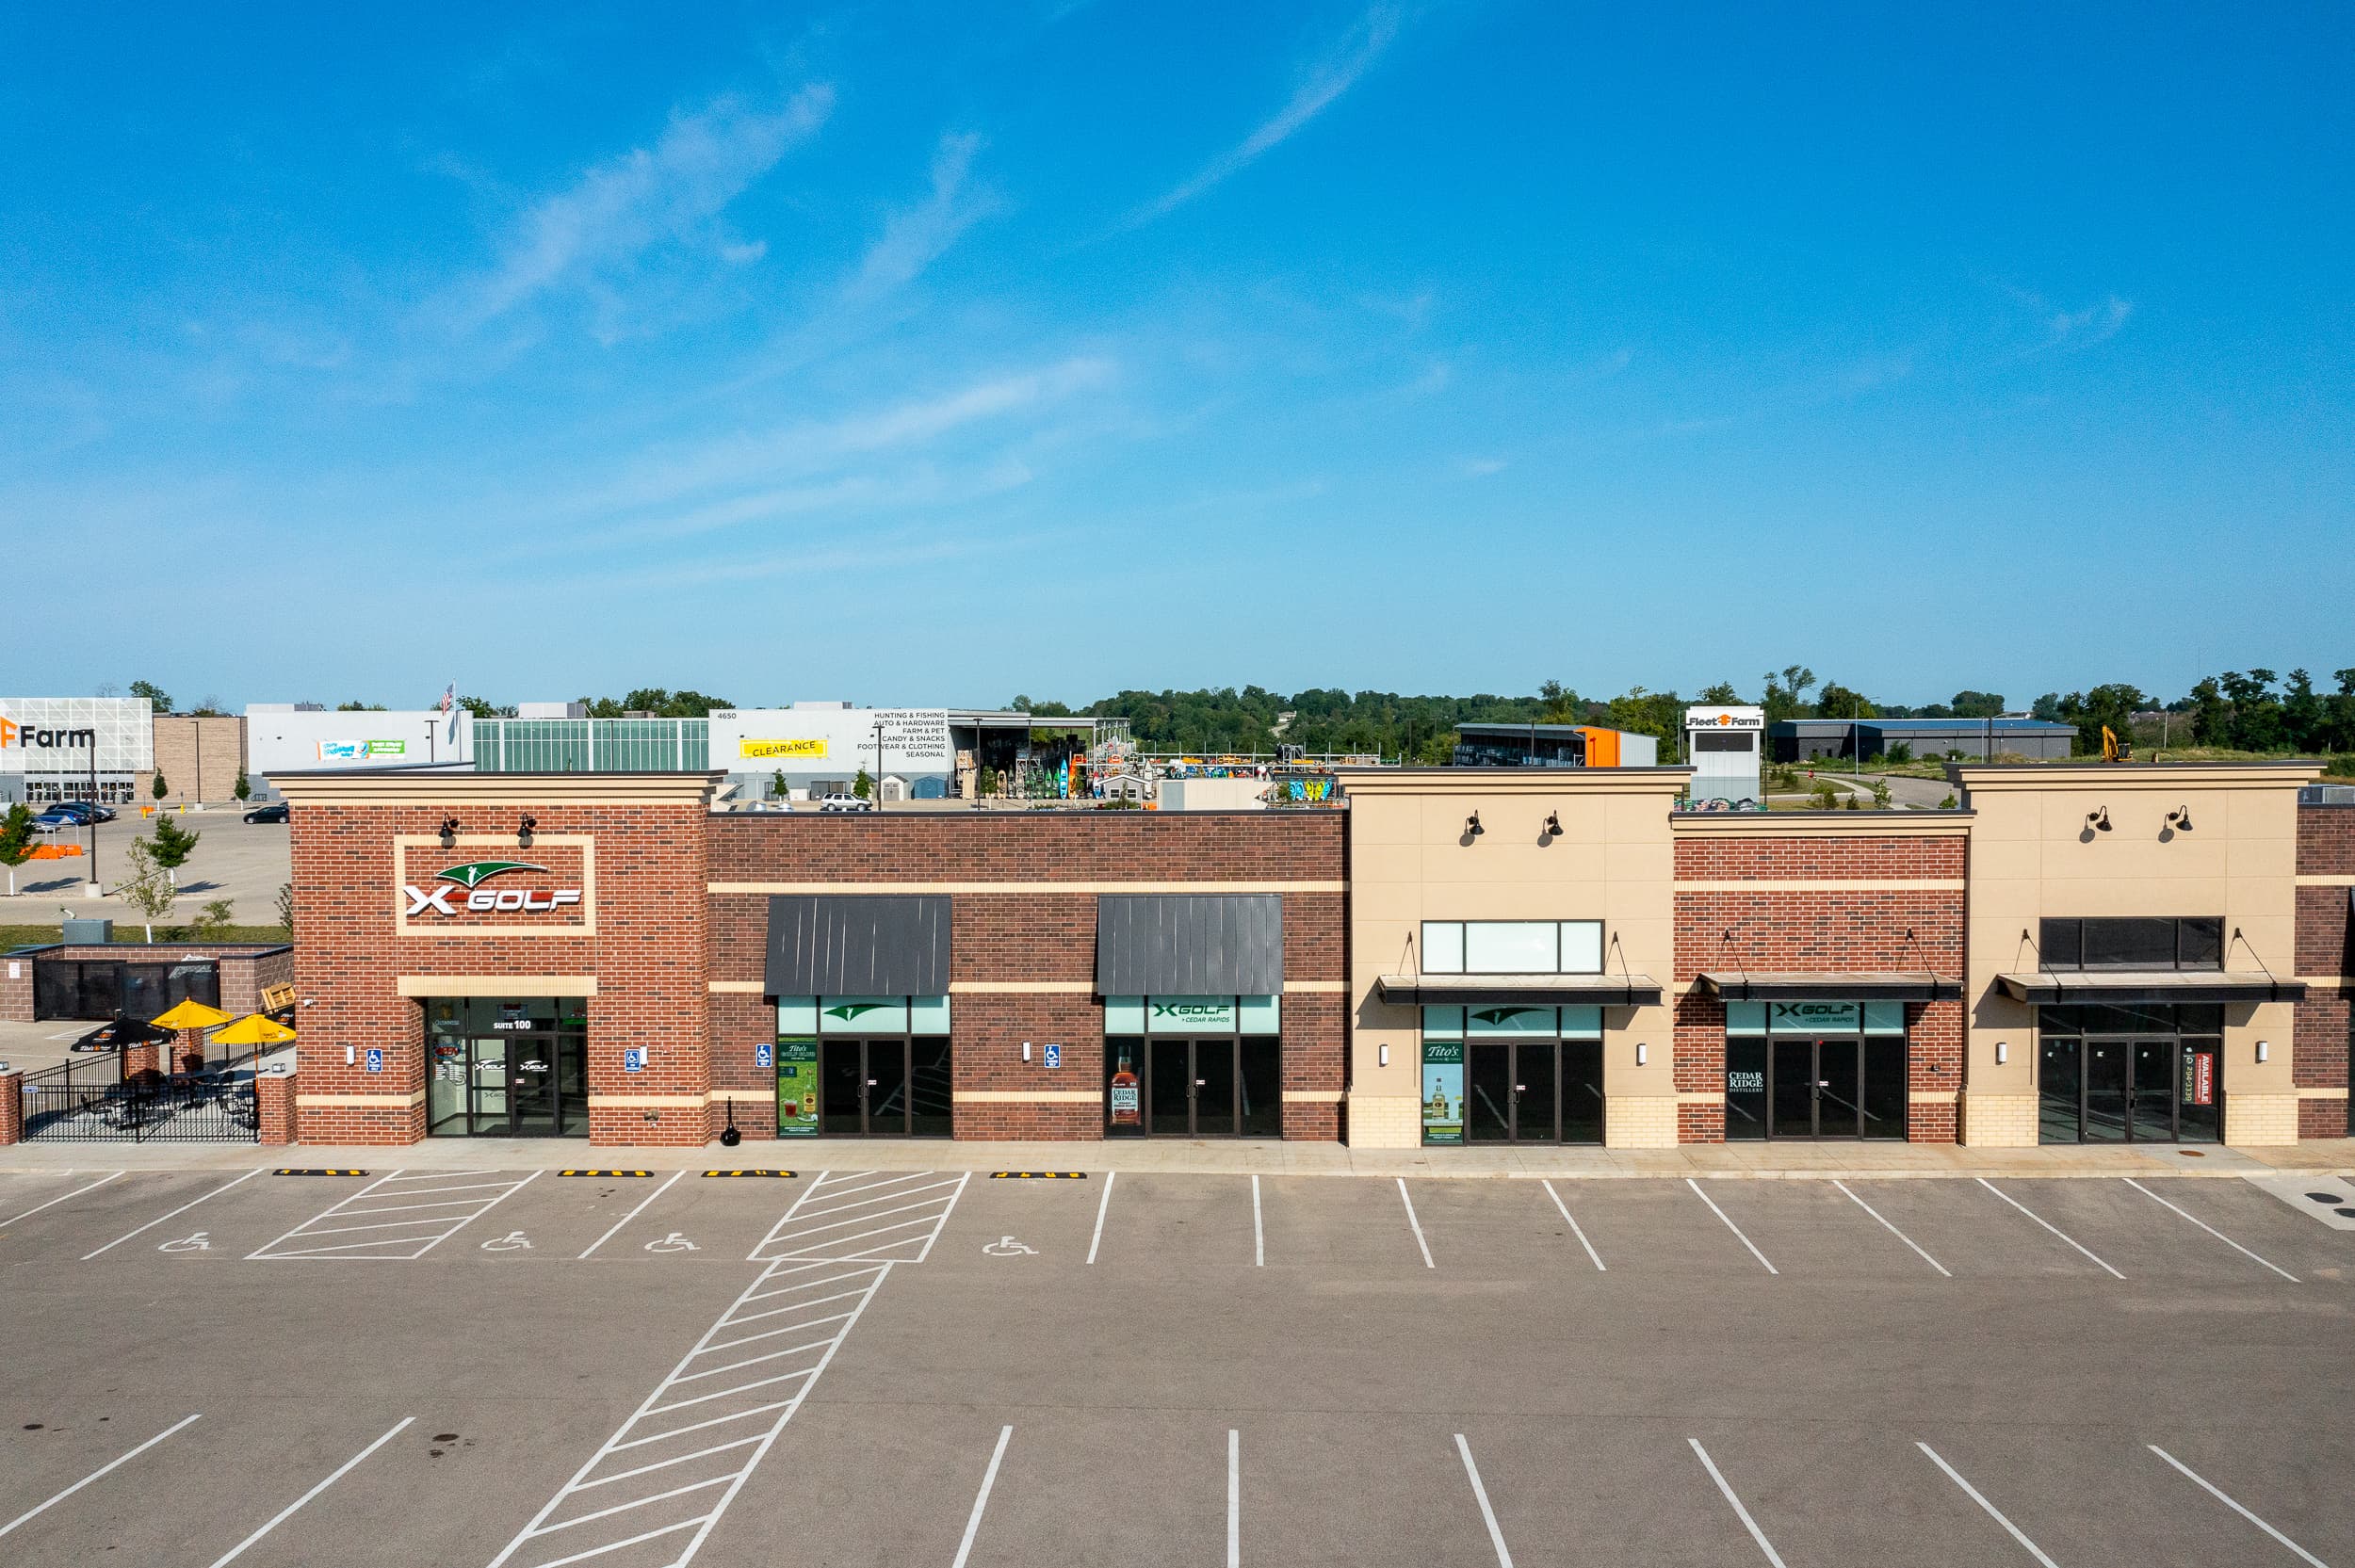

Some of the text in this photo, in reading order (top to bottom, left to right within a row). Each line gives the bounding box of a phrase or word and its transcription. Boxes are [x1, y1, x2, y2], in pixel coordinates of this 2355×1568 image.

[1689, 717, 1760, 726] Fleet Farm
[20, 725, 96, 748] Farm
[752, 740, 816, 757] CLEARANCE
[402, 885, 581, 915] X GOLF
[1152, 1003, 1230, 1017] X GOLF
[1776, 1003, 1855, 1017] X GOLF
[514, 1020, 531, 1029] 100
[1427, 1045, 1459, 1057] Tito's
[1729, 1072, 1762, 1080] CEDAR
[2201, 1055, 2210, 1102] AVAILABLE
[1729, 1079, 1763, 1088] RIDGE
